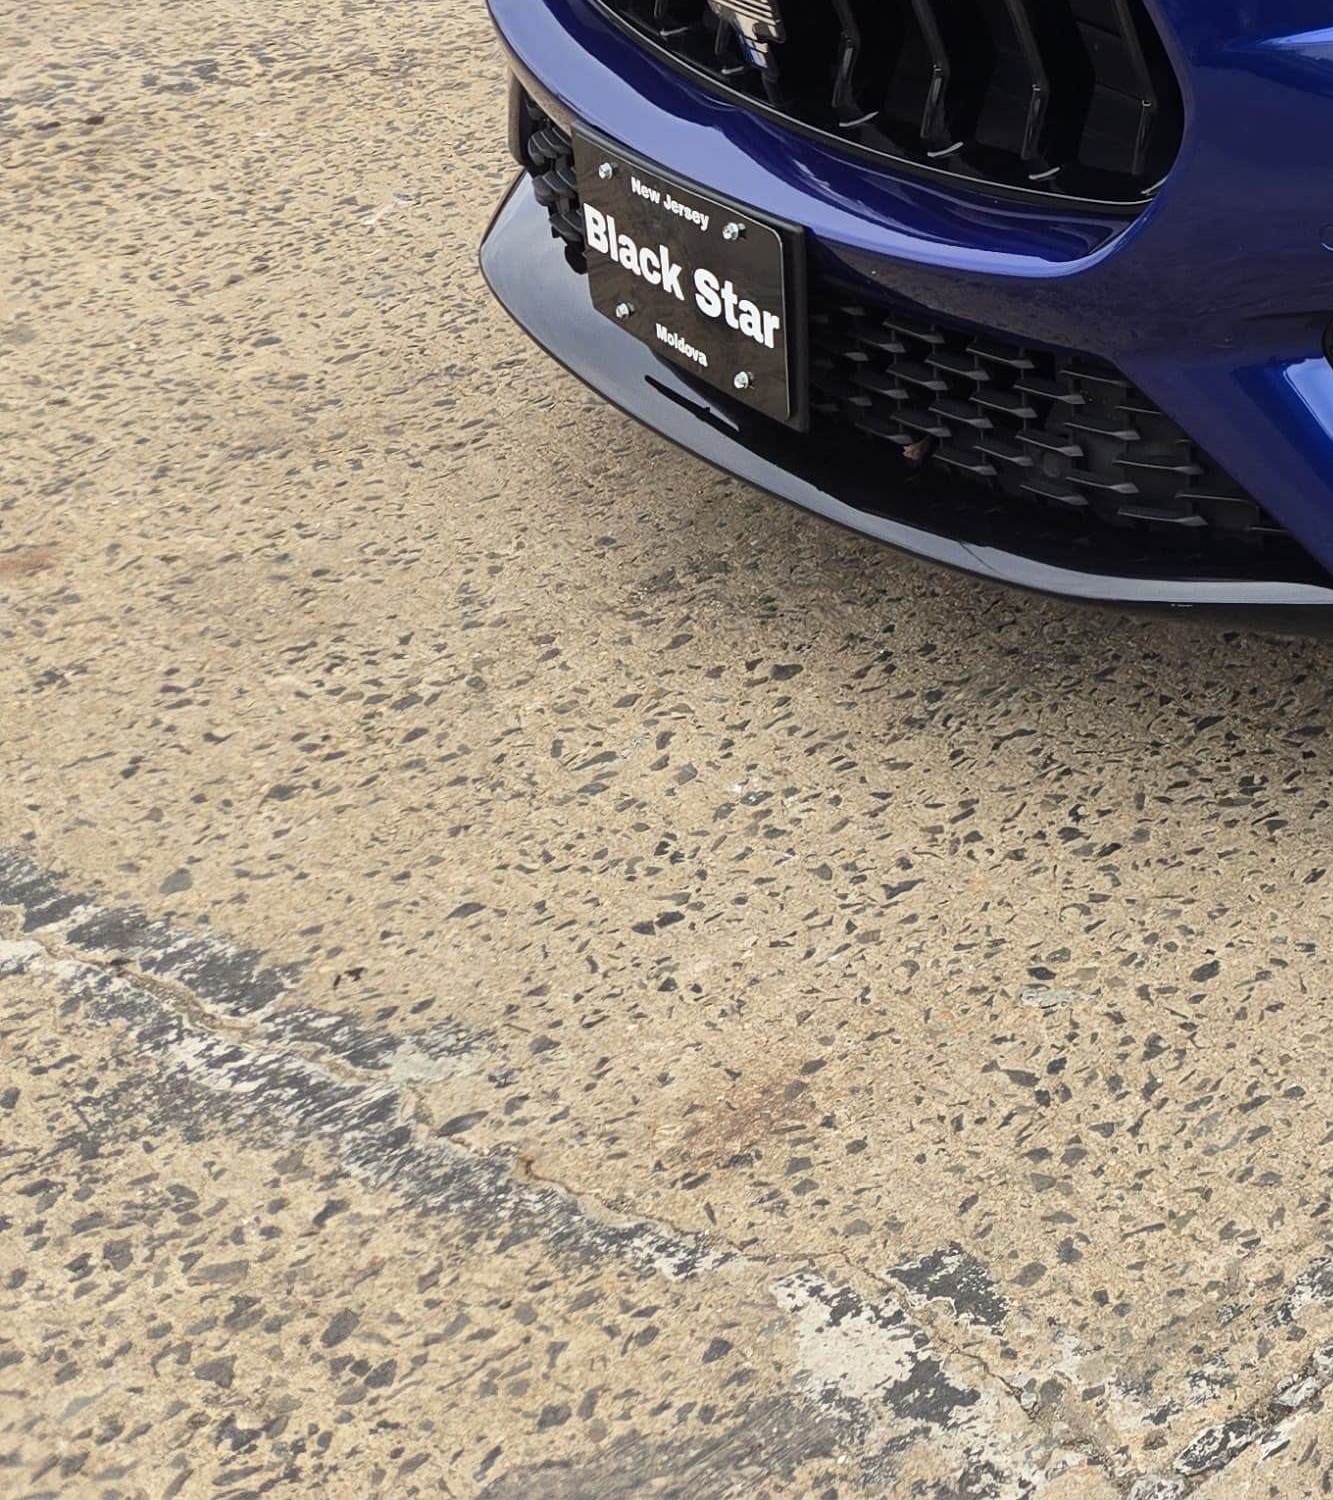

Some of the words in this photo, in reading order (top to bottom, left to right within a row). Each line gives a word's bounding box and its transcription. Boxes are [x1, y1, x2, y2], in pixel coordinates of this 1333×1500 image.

[631, 176, 661, 204] New
[663, 194, 709, 231] Jersey
[584, 203, 685, 300] Black
[694, 268, 780, 349] Star
[656, 322, 709, 367] Moldova
